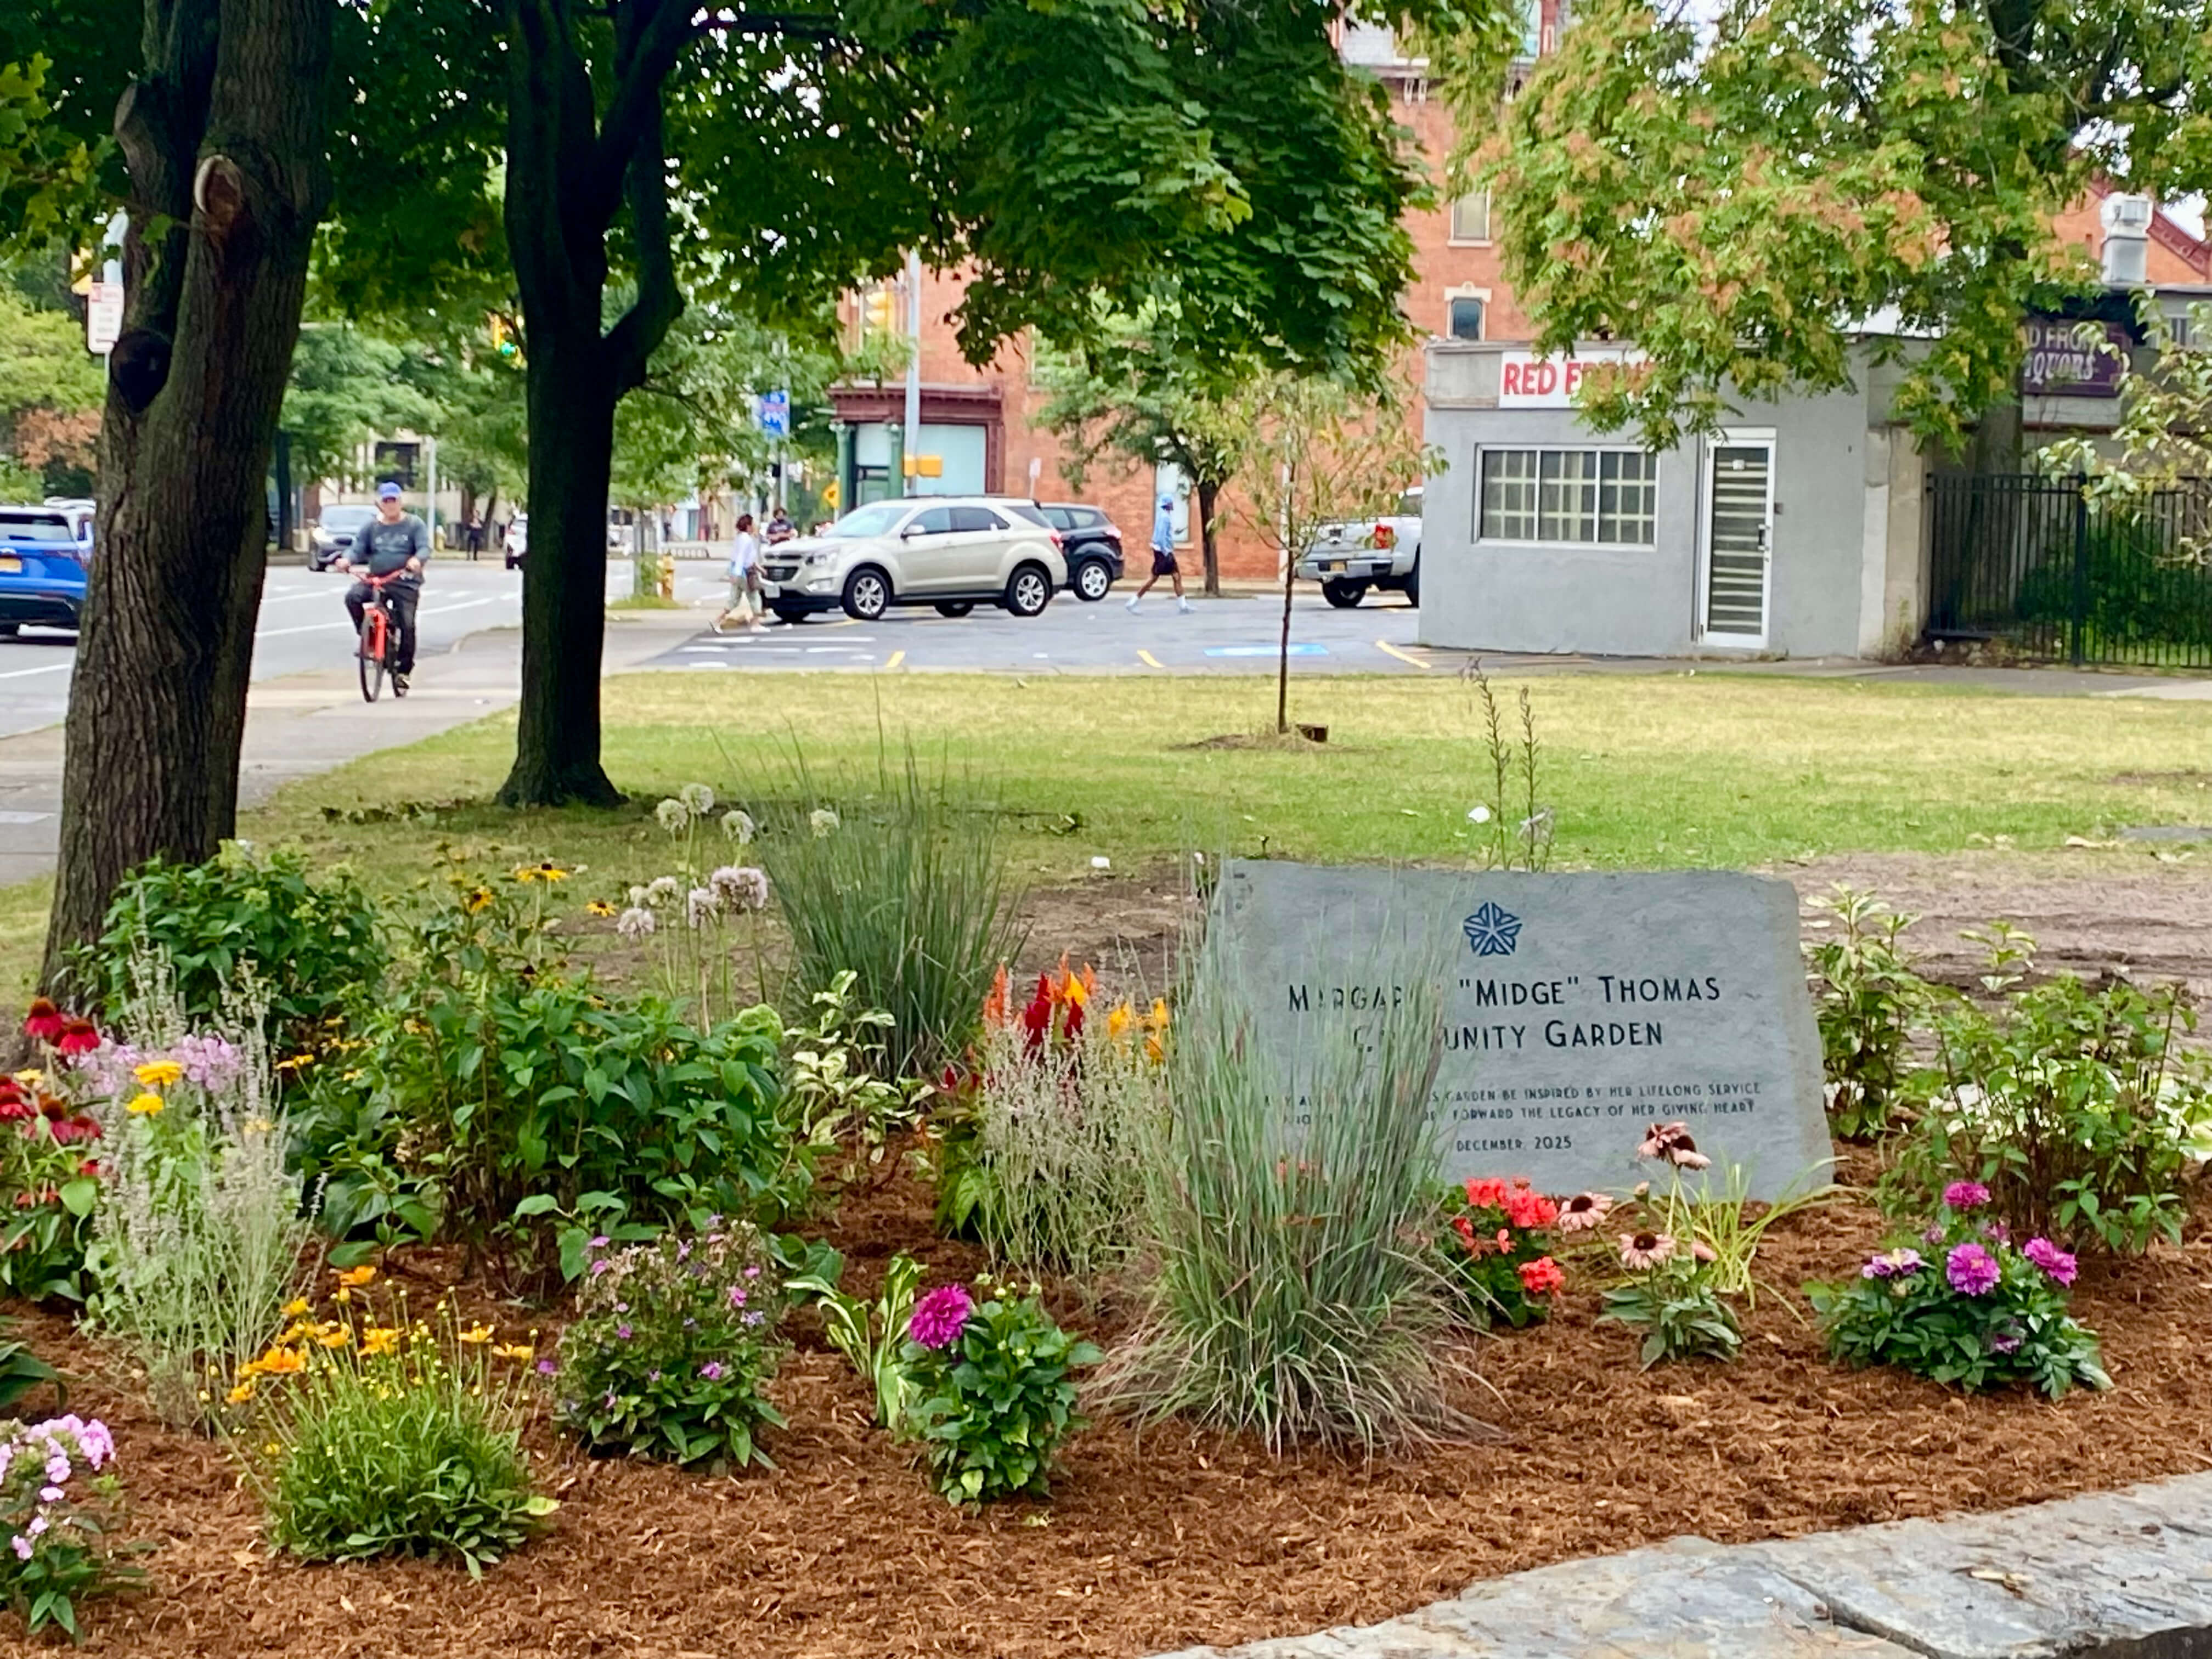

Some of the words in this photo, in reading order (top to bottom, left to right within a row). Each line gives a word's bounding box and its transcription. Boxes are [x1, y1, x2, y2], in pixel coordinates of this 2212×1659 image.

[1504, 362, 1557, 396] RED
[2024, 352, 2096, 385] IQUORS
[1289, 984, 1436, 1012] MRGAR
[1353, 1025, 1526, 1052] CUNITY
[1502, 1088, 1517, 1101] BE
[1525, 1087, 1579, 1099] INSPIRED
[1586, 1087, 1601, 1098] BY
[1610, 1086, 1632, 1097] HER
[1639, 1084, 1701, 1097] LIFELONG
[1708, 1082, 1761, 1096] SERVICE
[1453, 1108, 1513, 1121] FORWARD
[1520, 1107, 1543, 1119] THE
[1550, 1105, 1601, 1119] LEGACY
[1607, 1104, 1623, 1116] OF
[1632, 1103, 1655, 1116] HER
[1662, 1102, 1707, 1116] GIVING
[1713, 1098, 1754, 1114] HEART
[1534, 1136, 1572, 1150] 2025
